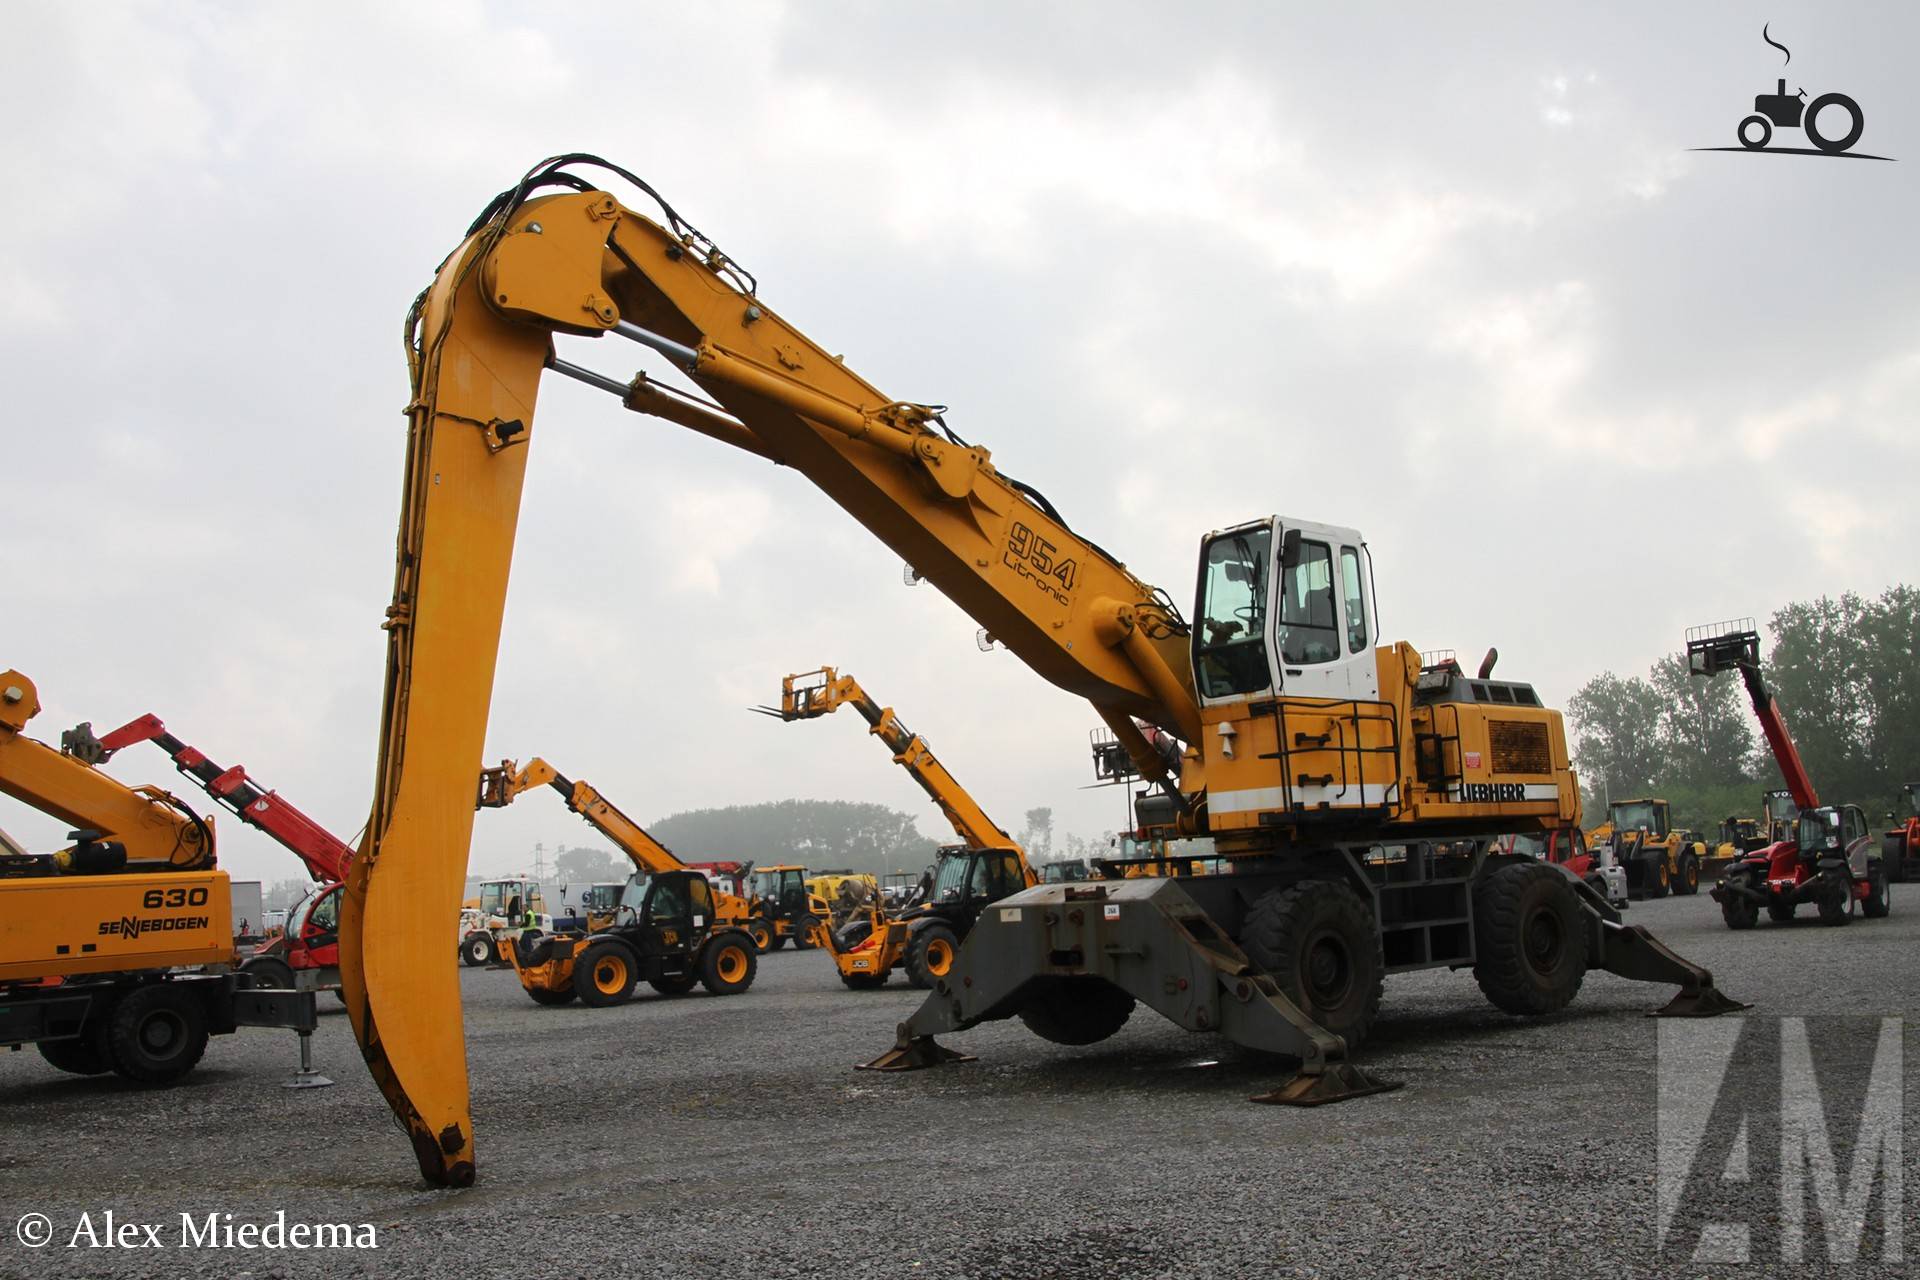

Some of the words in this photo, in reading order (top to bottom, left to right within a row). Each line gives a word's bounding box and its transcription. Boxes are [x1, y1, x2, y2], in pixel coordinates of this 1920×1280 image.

[1008, 521, 1076, 591] 954
[1003, 551, 1069, 607] Litronic
[1460, 783, 1526, 802] LIEBHERR
[143, 887, 208, 909] 630
[98, 915, 209, 940] SENNEBOGEN
[852, 960, 869, 968] JCB
